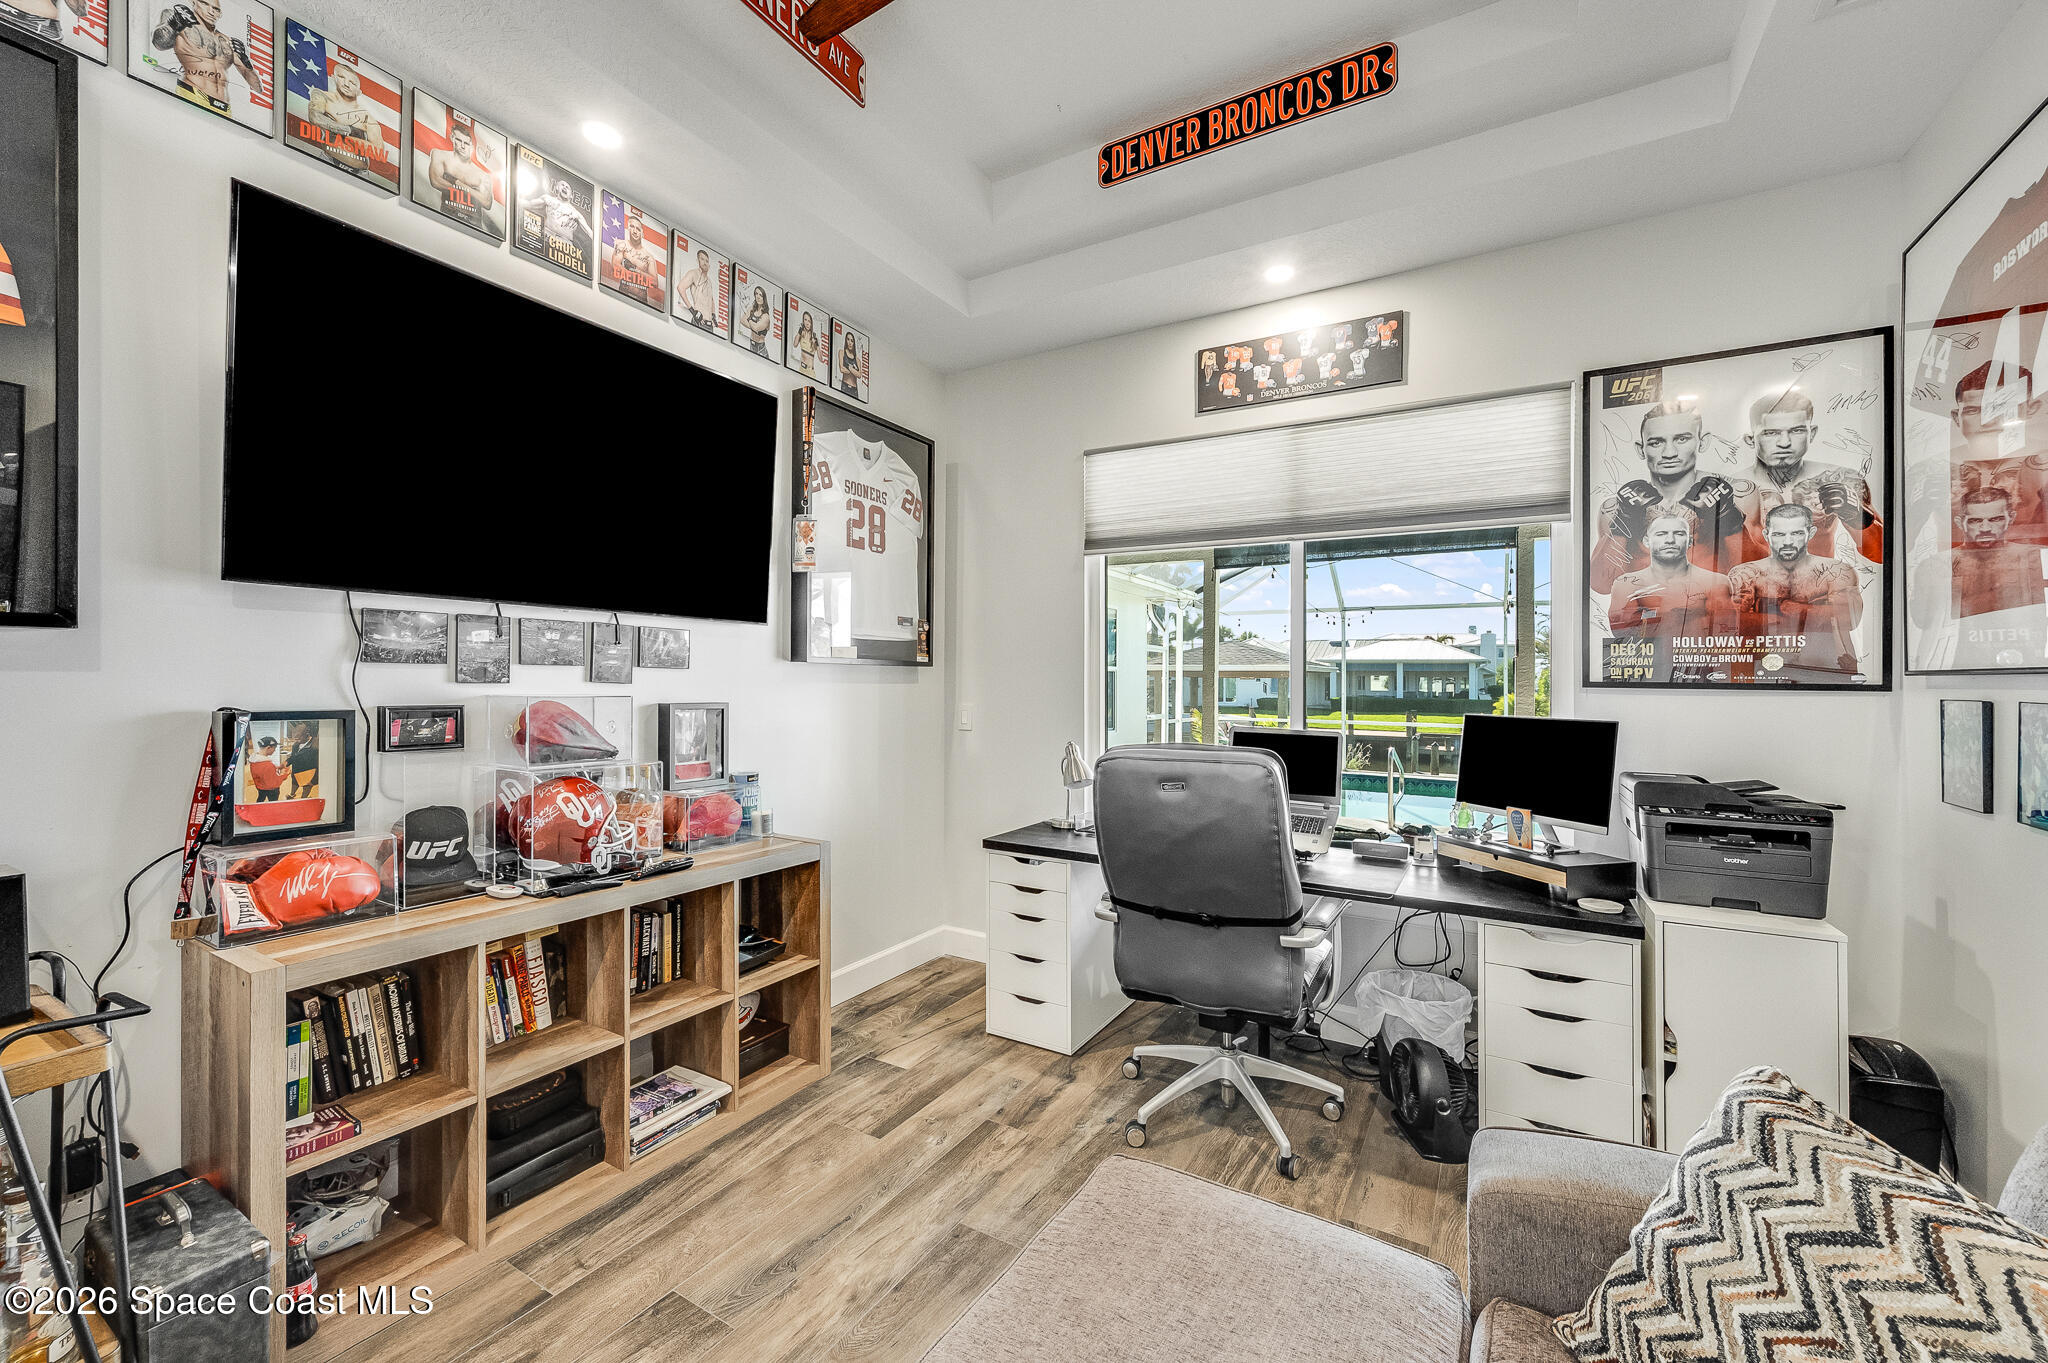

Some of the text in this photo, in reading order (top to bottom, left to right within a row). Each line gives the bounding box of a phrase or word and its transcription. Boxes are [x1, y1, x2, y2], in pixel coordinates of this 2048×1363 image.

[338, 51, 357, 64] UFC
[828, 41, 850, 78] AVE
[455, 112, 470, 124] UFC
[1110, 53, 1381, 180] DENVER BRONCOS DR
[299, 120, 390, 164] DILLASHAW
[522, 151, 541, 166] UFC
[447, 186, 475, 208] TILL
[548, 235, 583, 261] CHUCK
[548, 247, 589, 275] LIDDELL
[613, 263, 656, 289] GAETHJE
[1921, 334, 1953, 385] 44
[1260, 386, 1290, 398] DENVER
[1291, 380, 1328, 393] BRONCOS
[1610, 373, 1657, 395] UFC
[1627, 390, 1652, 402] 206
[844, 478, 888, 506] SOONERS
[1703, 482, 1731, 509] UFC
[900, 488, 923, 523] 28
[845, 497, 887, 555] 28
[1610, 643, 1655, 657] DEC 10
[1672, 635, 1744, 648] HOLLOWAY
[1755, 635, 1807, 648] PETTIS
[1610, 657, 1654, 667] SATURDAY
[1672, 654, 1711, 663] COWBOY
[1718, 654, 1754, 663] BROWN
[1611, 667, 1655, 680] ON PPV
[555, 791, 595, 828] OU
[200, 813, 219, 834] Finals
[406, 836, 464, 860] UFC
[590, 846, 612, 875] OU
[1723, 857, 1750, 865] brother
[230, 886, 266, 927] EVERLAST
[641, 916, 652, 957] BLACKWATER
[506, 979, 515, 997] Costa
[518, 976, 530, 998] PABLO
[527, 954, 549, 1007] FIASCO
[485, 983, 497, 1004] DEATH
[387, 983, 409, 1065] MODERN MYSTERIES OF BRITAIN
[405, 1001, 416, 1037] The Long Walk
[313, 1020, 329, 1059] EMPIRE
[365, 1028, 375, 1049] FRAGILITY
[331, 1217, 369, 1241] RECOIL
